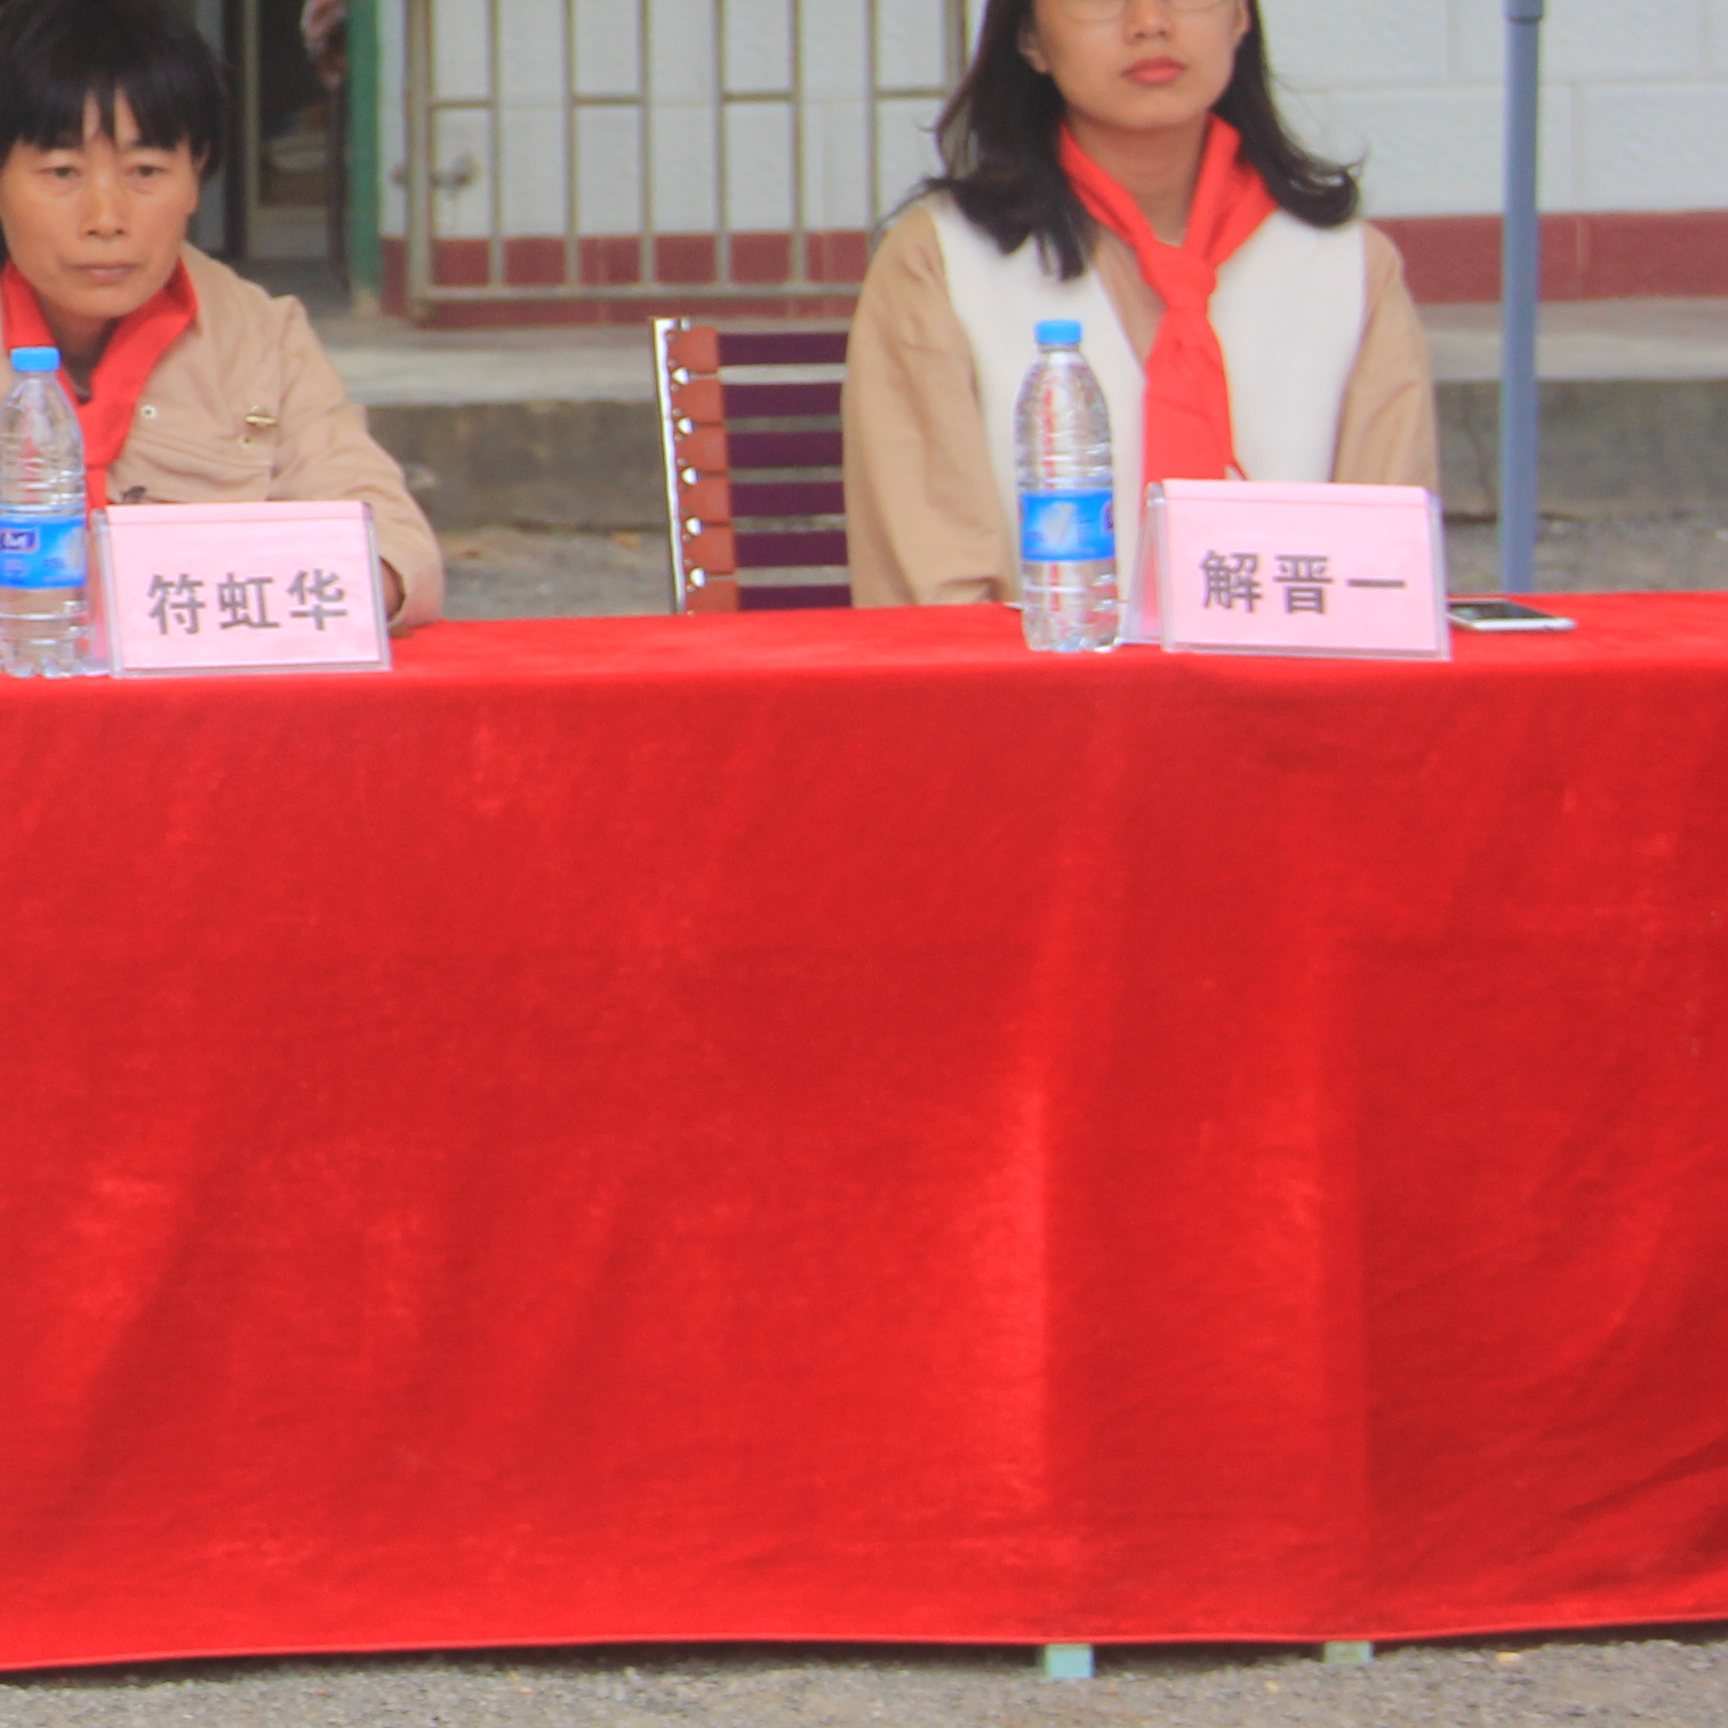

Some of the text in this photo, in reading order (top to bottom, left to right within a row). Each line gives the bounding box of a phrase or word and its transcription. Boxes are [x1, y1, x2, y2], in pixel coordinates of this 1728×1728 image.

[146, 570, 348, 635] 符虹华
[1199, 550, 1407, 614] 解晋一
